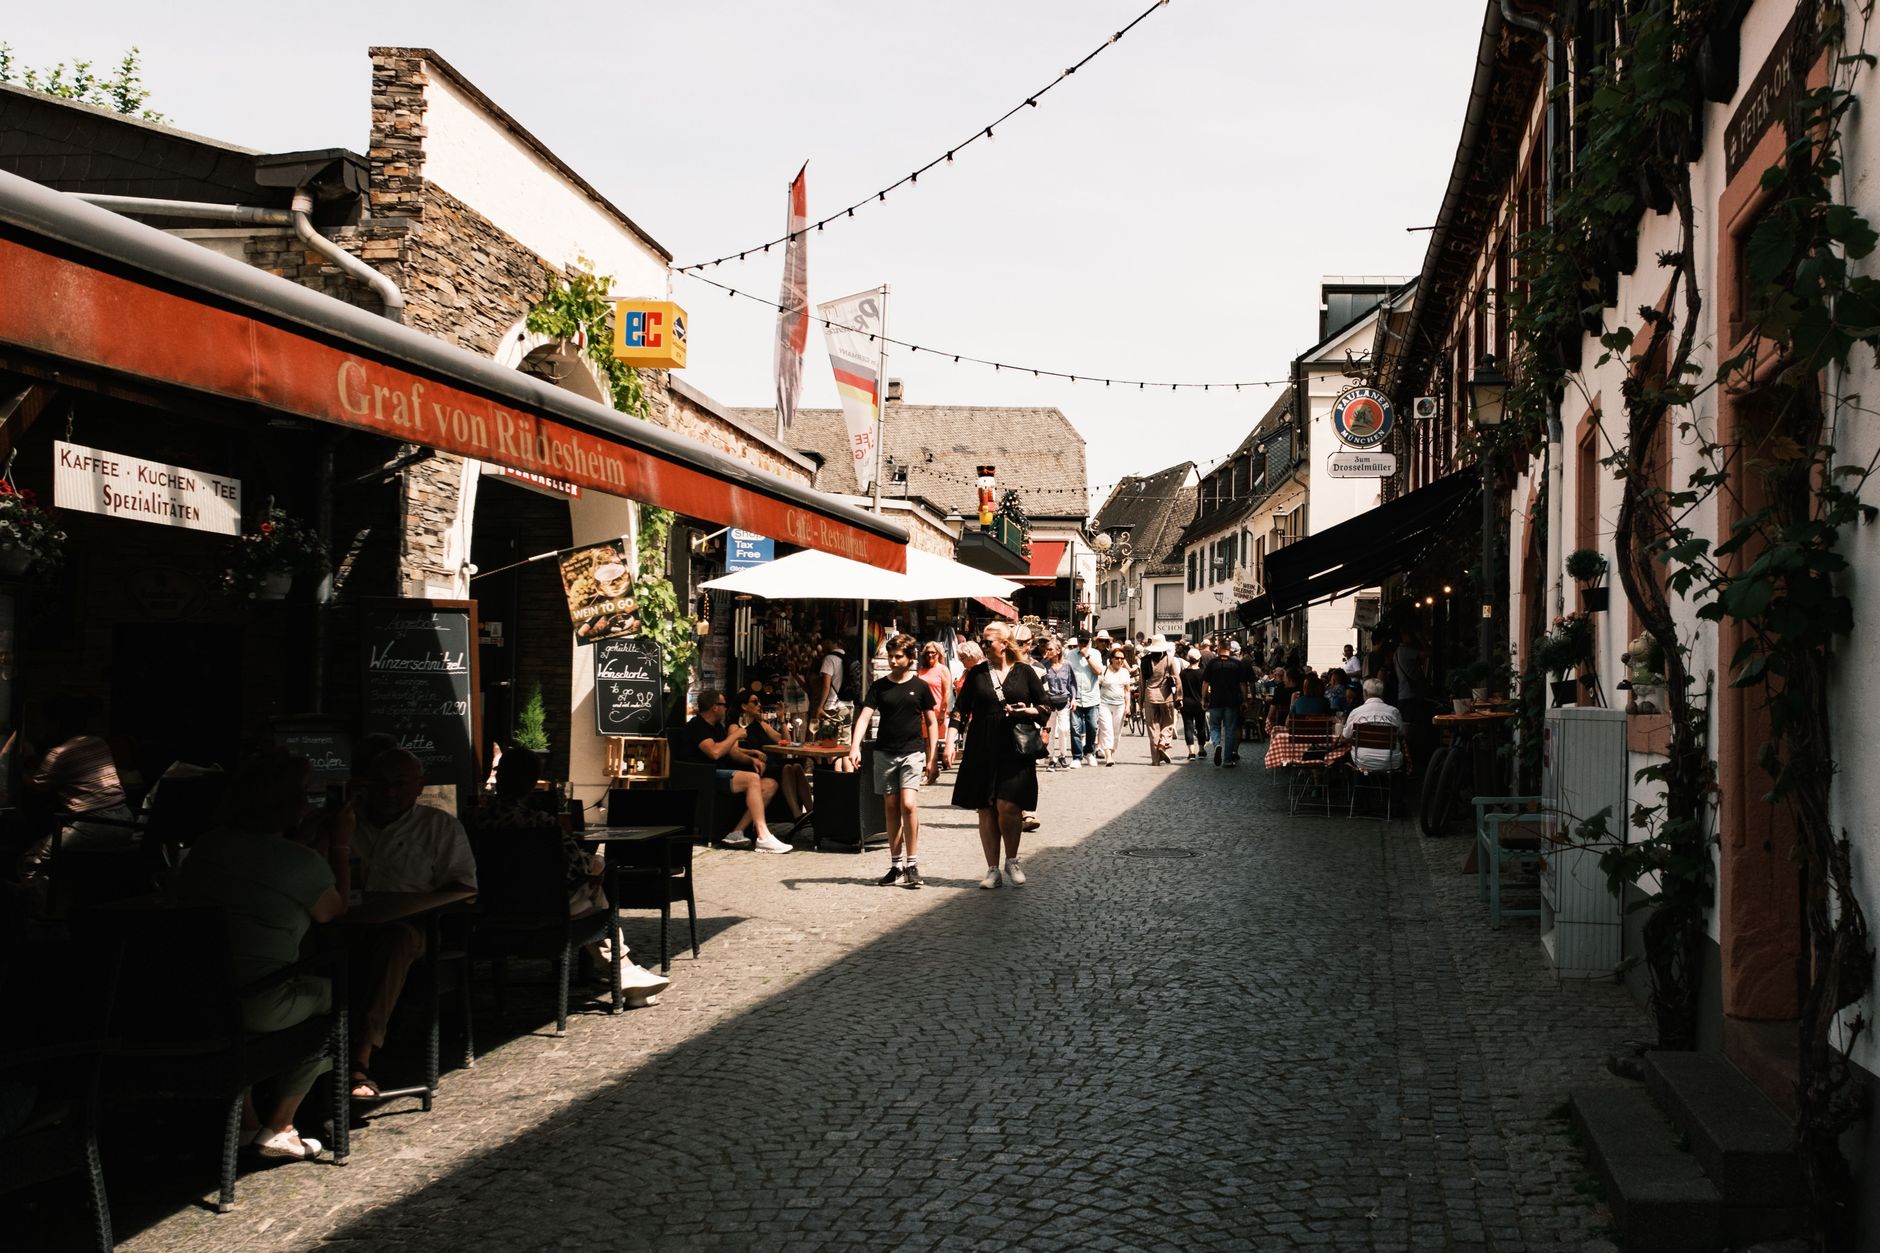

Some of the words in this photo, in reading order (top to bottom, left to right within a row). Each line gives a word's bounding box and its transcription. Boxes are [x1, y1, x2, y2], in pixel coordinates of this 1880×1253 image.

[1336, 389, 1390, 411] PAULANER
[338, 360, 424, 431] Graf
[432, 401, 488, 448] von
[493, 408, 627, 487] Rüdesheim
[1333, 463, 1392, 472] Drosselmüller
[735, 540, 754, 549] Tax
[736, 549, 761, 559] Free
[573, 606, 599, 620] WEIN
[601, 601, 615, 613] TO
[617, 598, 634, 609] GO
[369, 640, 467, 671] Winzerschnitzel
